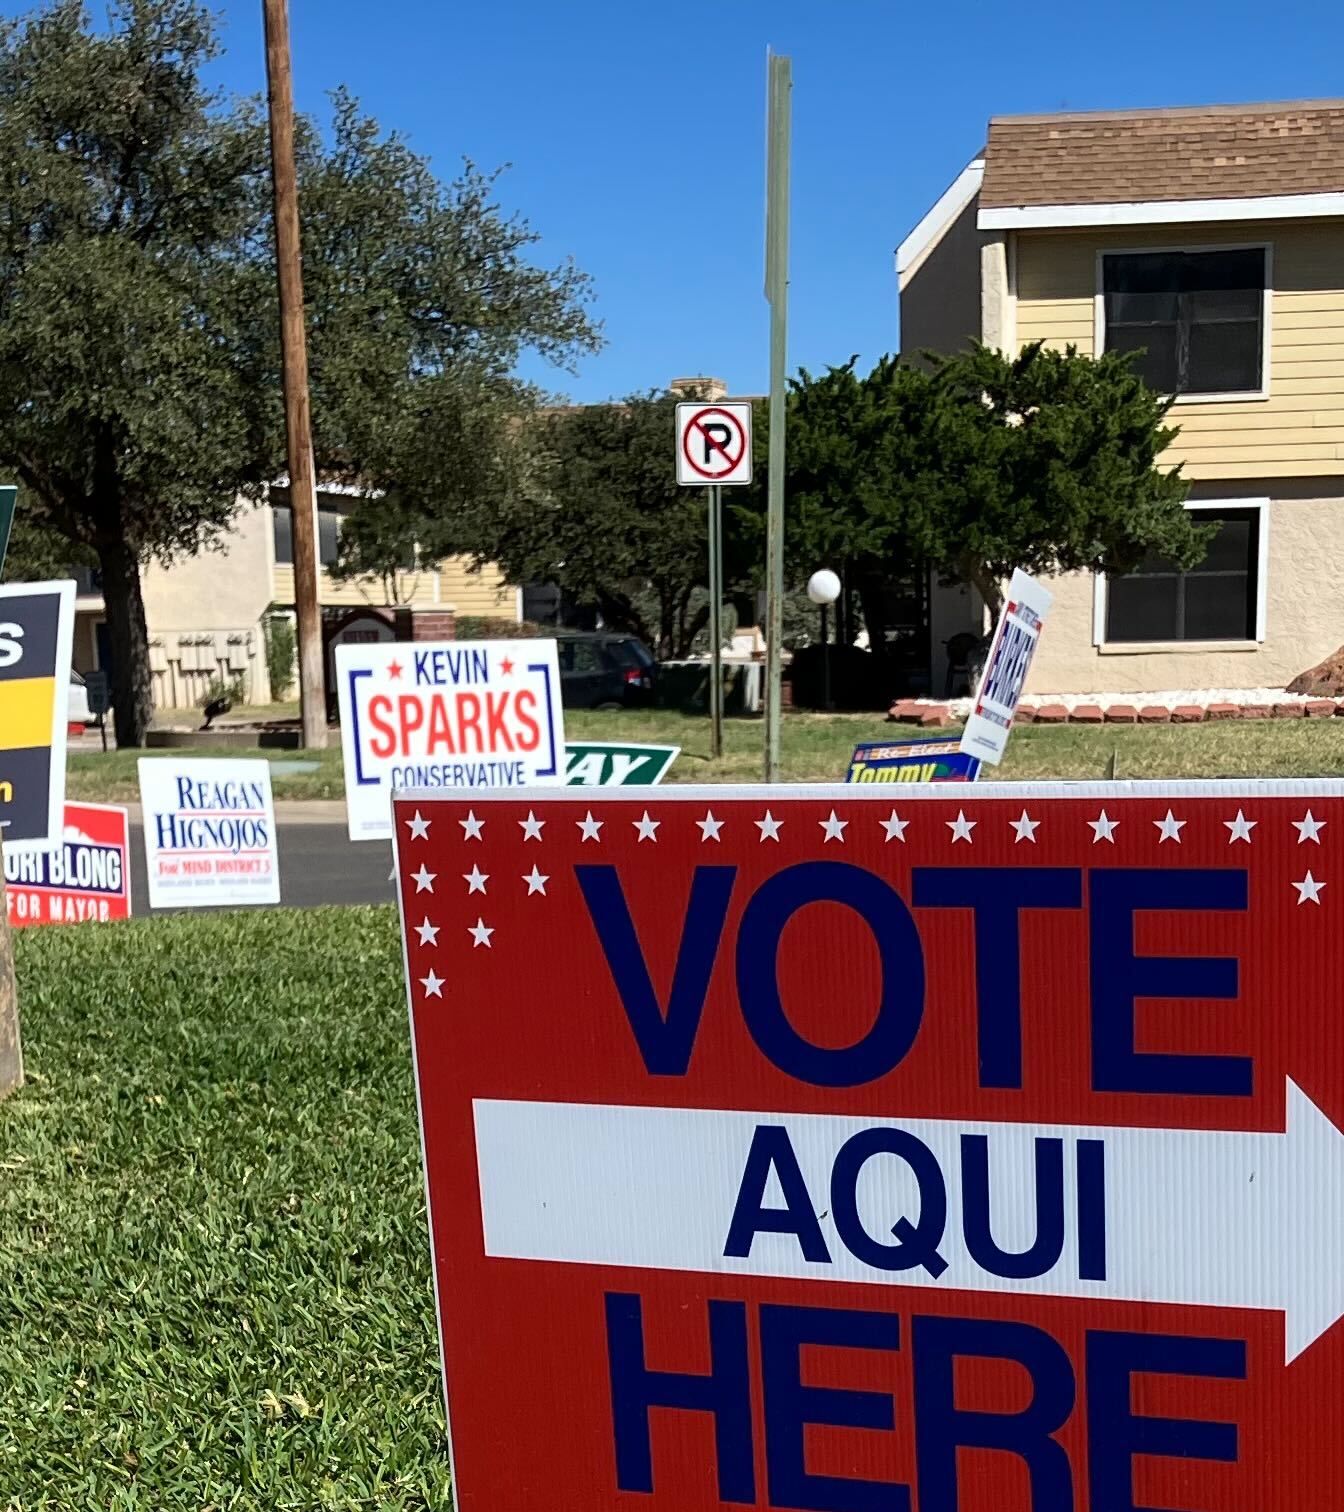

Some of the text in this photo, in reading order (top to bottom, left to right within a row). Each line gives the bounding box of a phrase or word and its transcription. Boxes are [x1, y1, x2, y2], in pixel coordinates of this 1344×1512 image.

[415, 649, 489, 686] KEVIN
[367, 689, 541, 760] SPARKS
[175, 776, 264, 810] REAGAN
[392, 761, 525, 787] CONSERVATIVE
[154, 813, 268, 855] HIGNOJOS
[49, 845, 121, 890] BLONG
[6, 892, 109, 923] FOR MAYOR
[573, 860, 1254, 1097] VOTE
[722, 1125, 1108, 1282] AQUI
